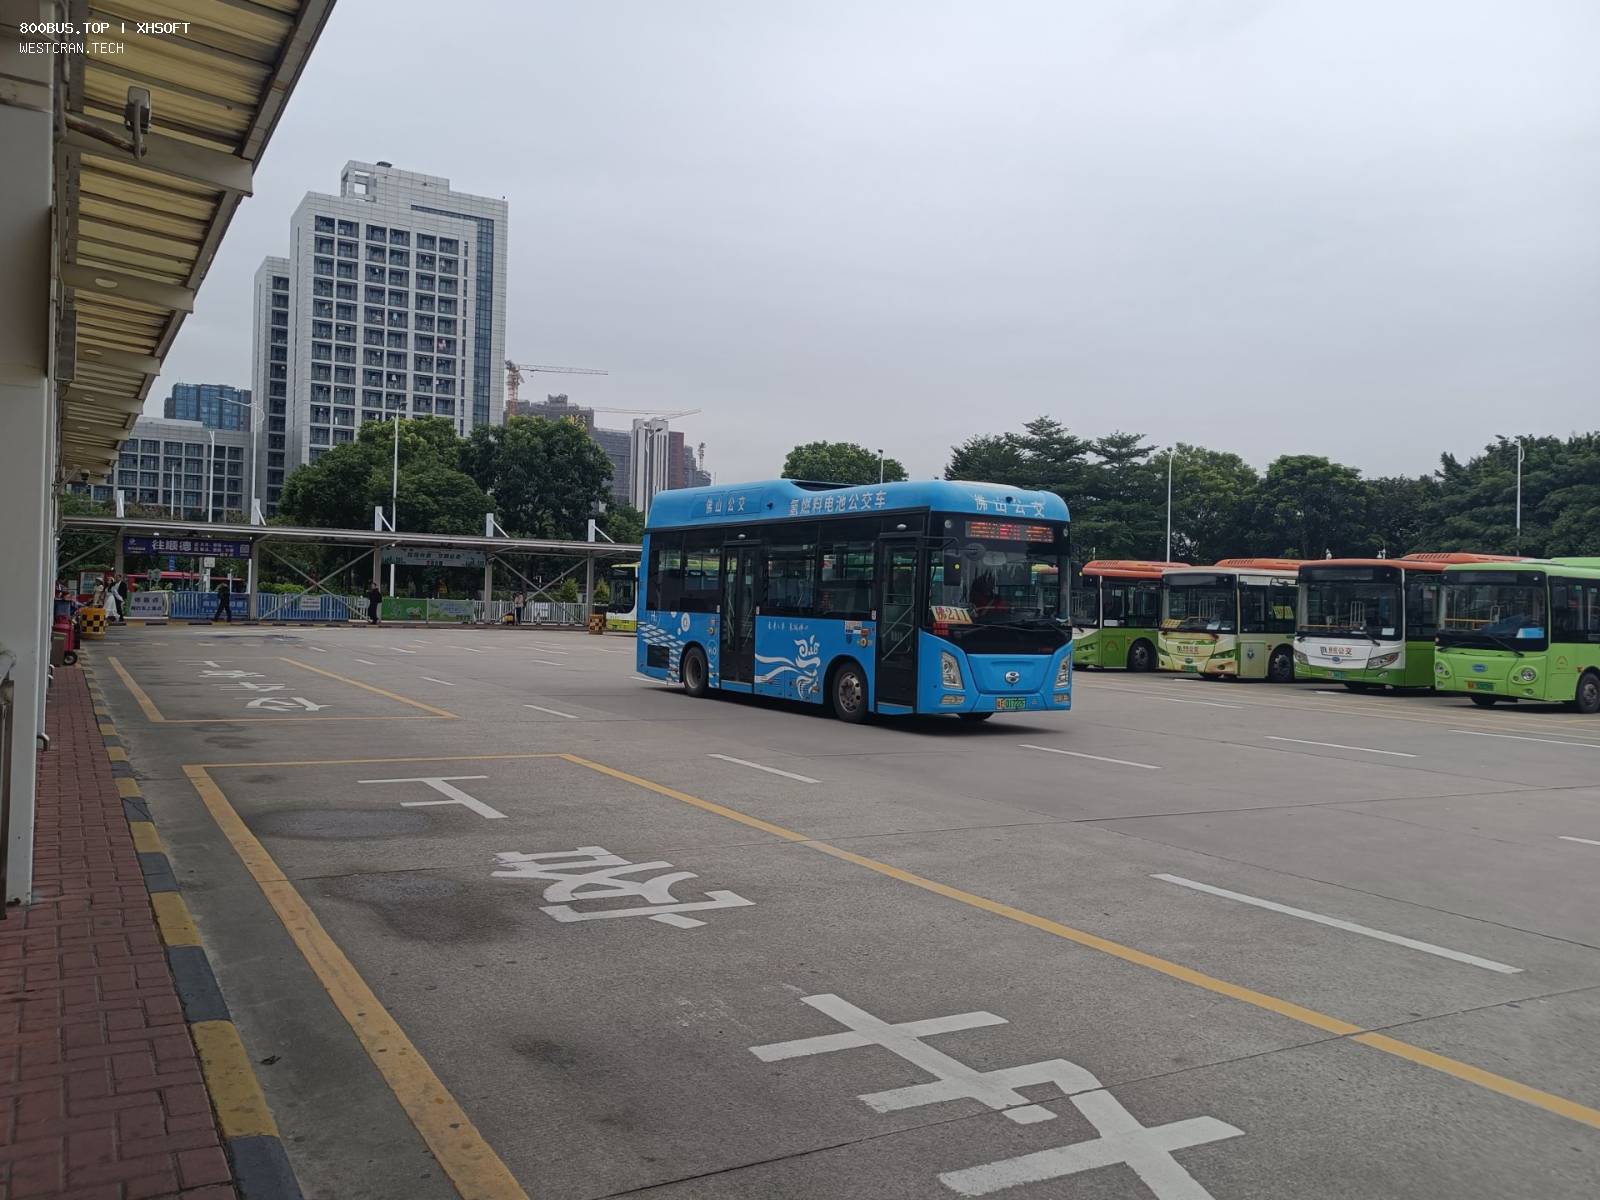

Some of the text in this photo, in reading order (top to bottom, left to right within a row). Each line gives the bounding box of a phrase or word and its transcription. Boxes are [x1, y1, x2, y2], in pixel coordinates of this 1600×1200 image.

[706, 495, 745, 514] 佛山公交
[789, 490, 887, 516] 氢燃料电池公交车
[973, 494, 1045, 518] 佛山公交
